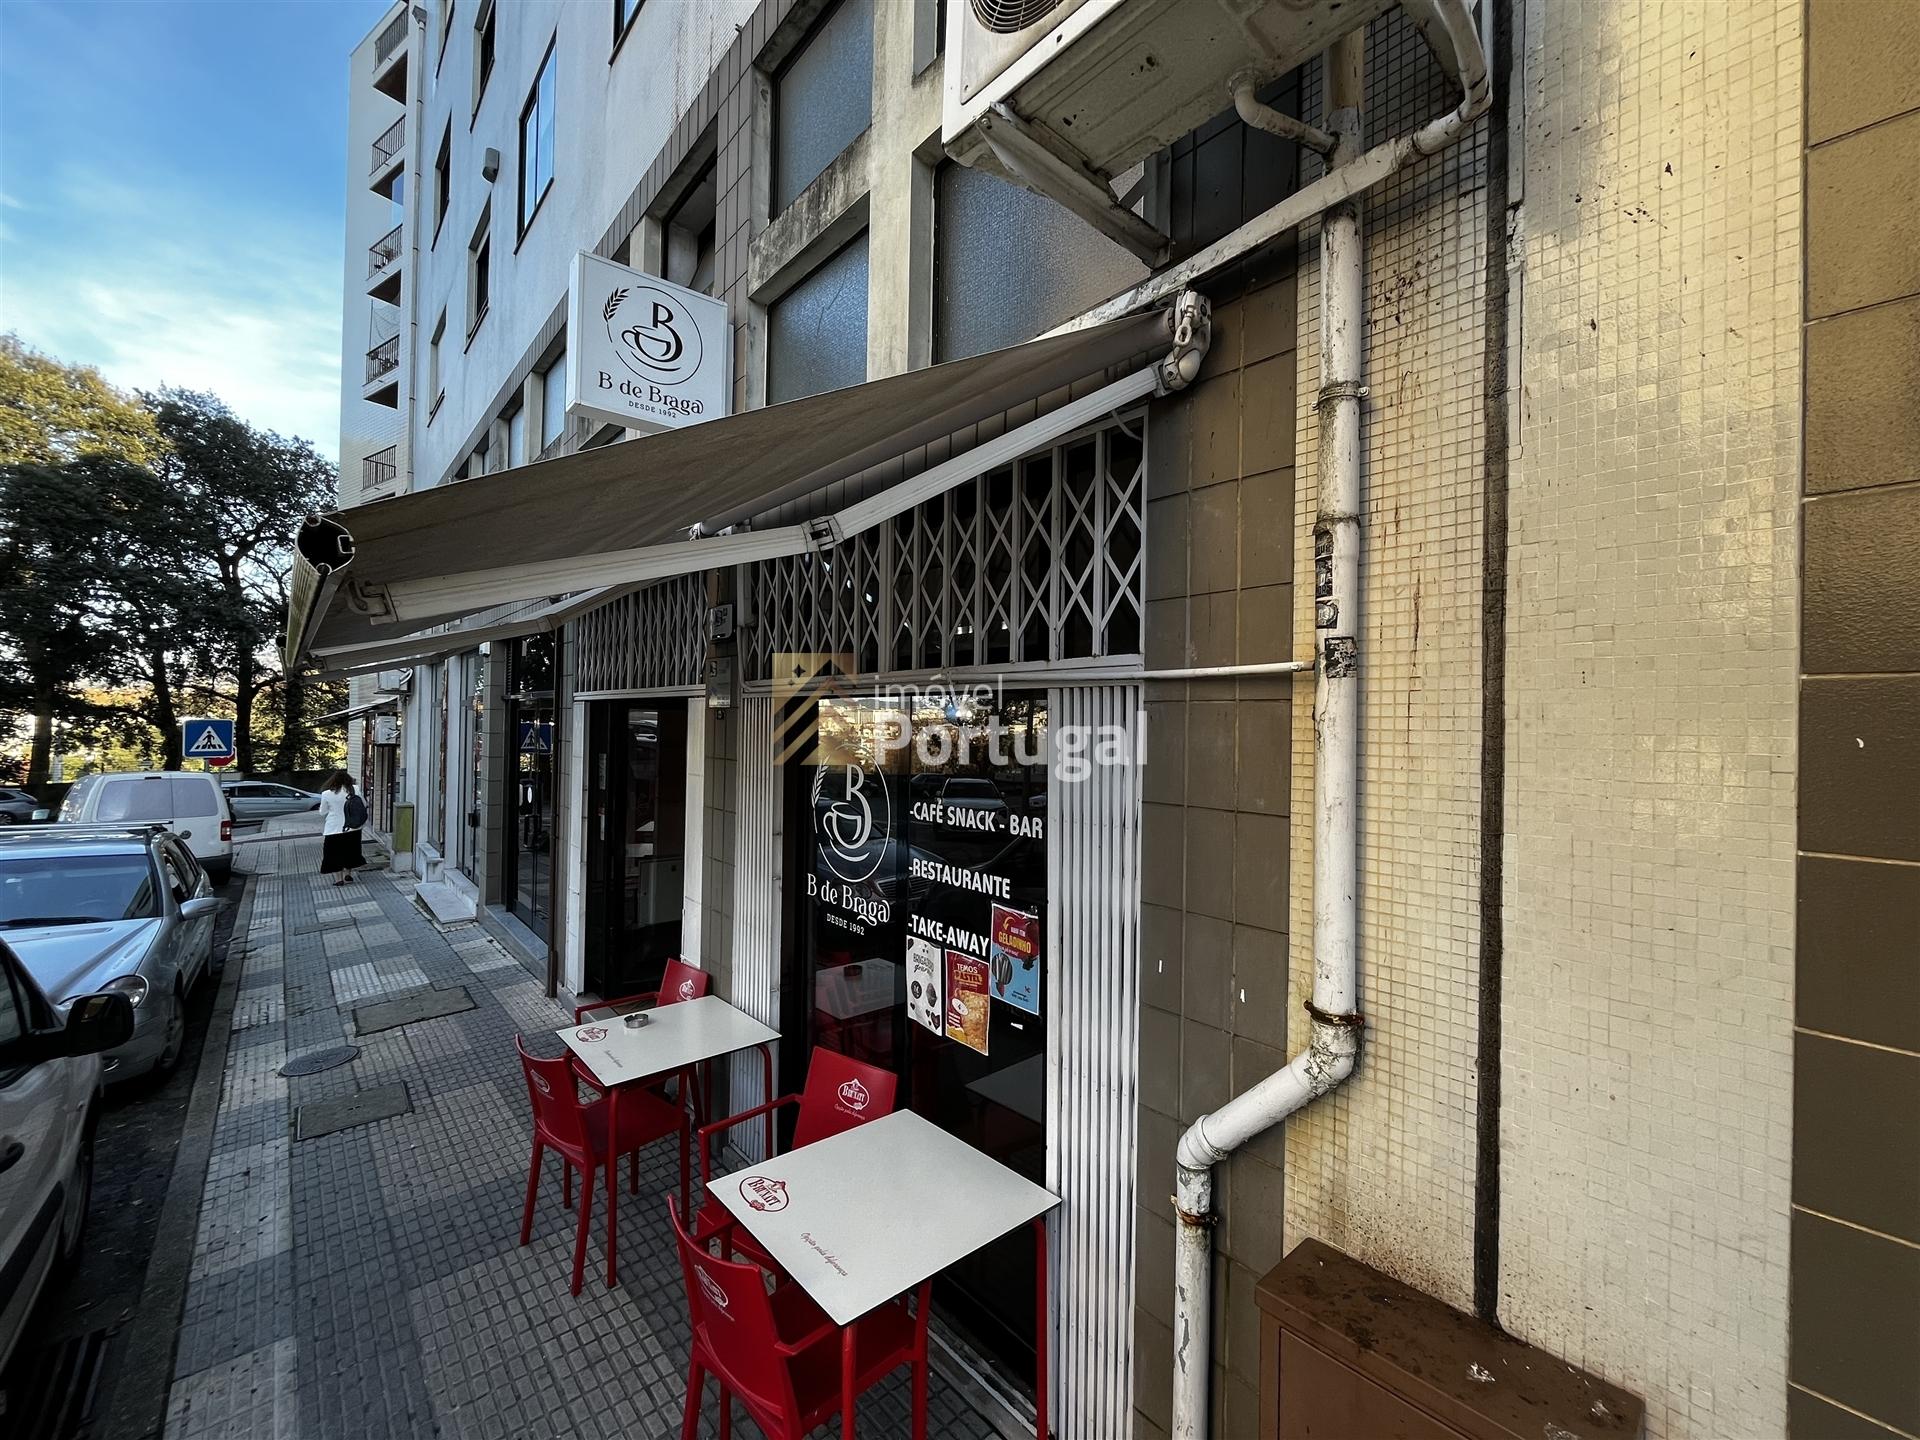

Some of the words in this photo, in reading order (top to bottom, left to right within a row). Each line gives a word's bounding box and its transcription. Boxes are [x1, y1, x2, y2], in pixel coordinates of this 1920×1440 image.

[598, 371, 613, 389] B
[619, 380, 642, 398] de
[649, 385, 704, 416] Braga
[628, 400, 656, 413] DESDE
[658, 408, 677, 419] 1992
[909, 798, 944, 824] -CAFÉ
[947, 806, 996, 832] SNACK
[1009, 814, 1043, 839] BAR
[908, 858, 1011, 899] -RESTAURANTE
[807, 873, 817, 896] B
[821, 880, 838, 904] de
[842, 885, 891, 926] Braga
[826, 913, 848, 929] DESDE
[849, 922, 865, 936] 1992
[907, 914, 990, 957] -TAKE-AWAY
[957, 963, 978, 974] TEMOS
